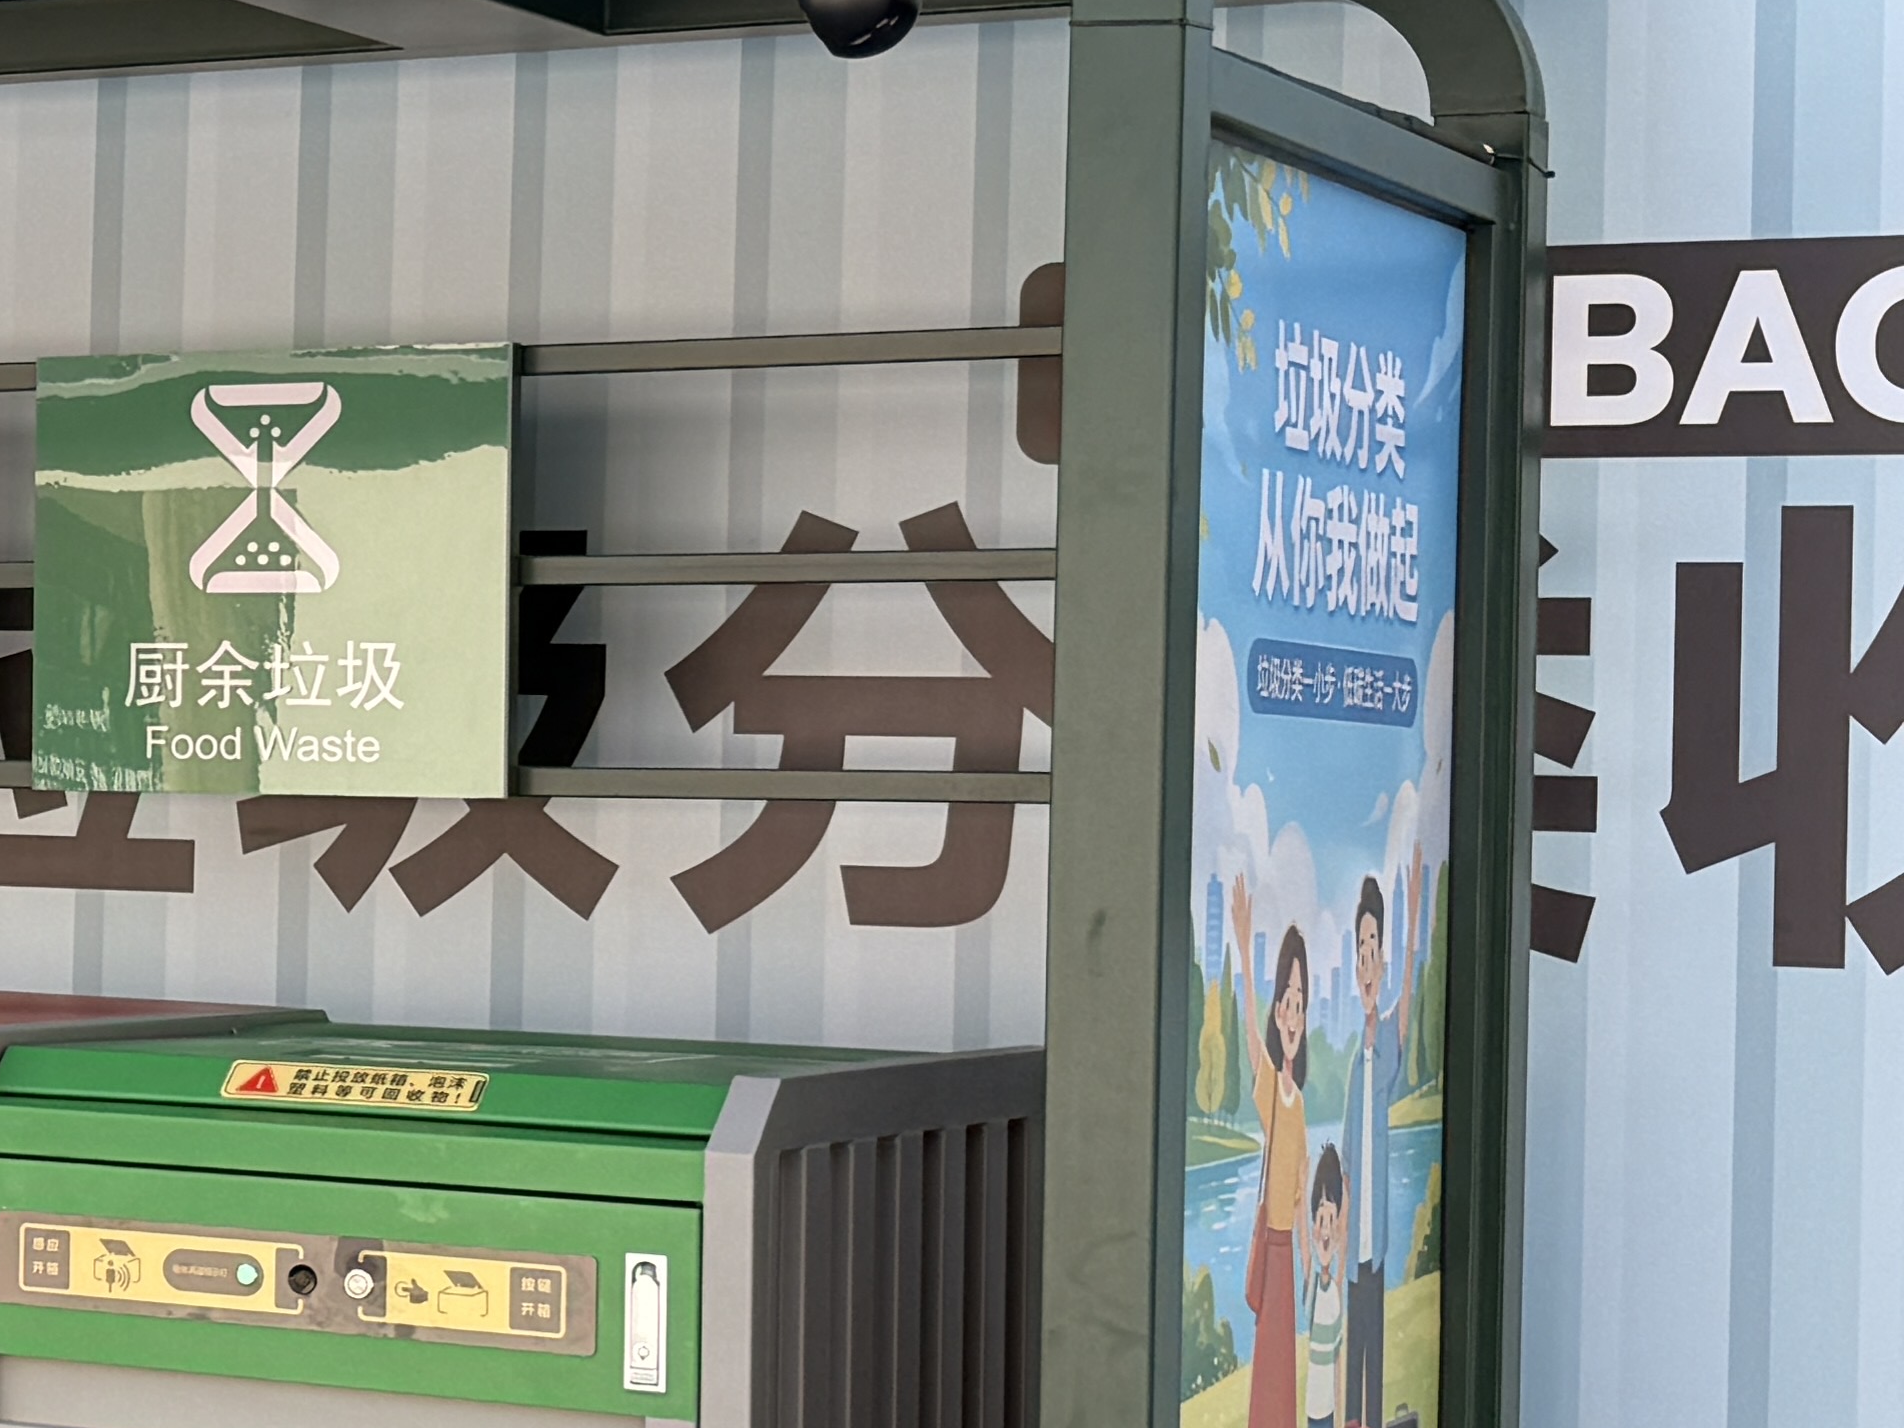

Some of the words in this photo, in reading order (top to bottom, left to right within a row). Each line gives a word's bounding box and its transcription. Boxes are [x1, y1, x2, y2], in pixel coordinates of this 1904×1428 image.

[1272, 320, 1406, 480] 垃圾分类
[1252, 469, 1420, 625] 从你我做起
[123, 638, 405, 712] 厨余垃圾
[145, 724, 245, 763] Food
[254, 724, 381, 764] Waste
[293, 1068, 467, 1090] 禁止投放纸箱、泡沫
